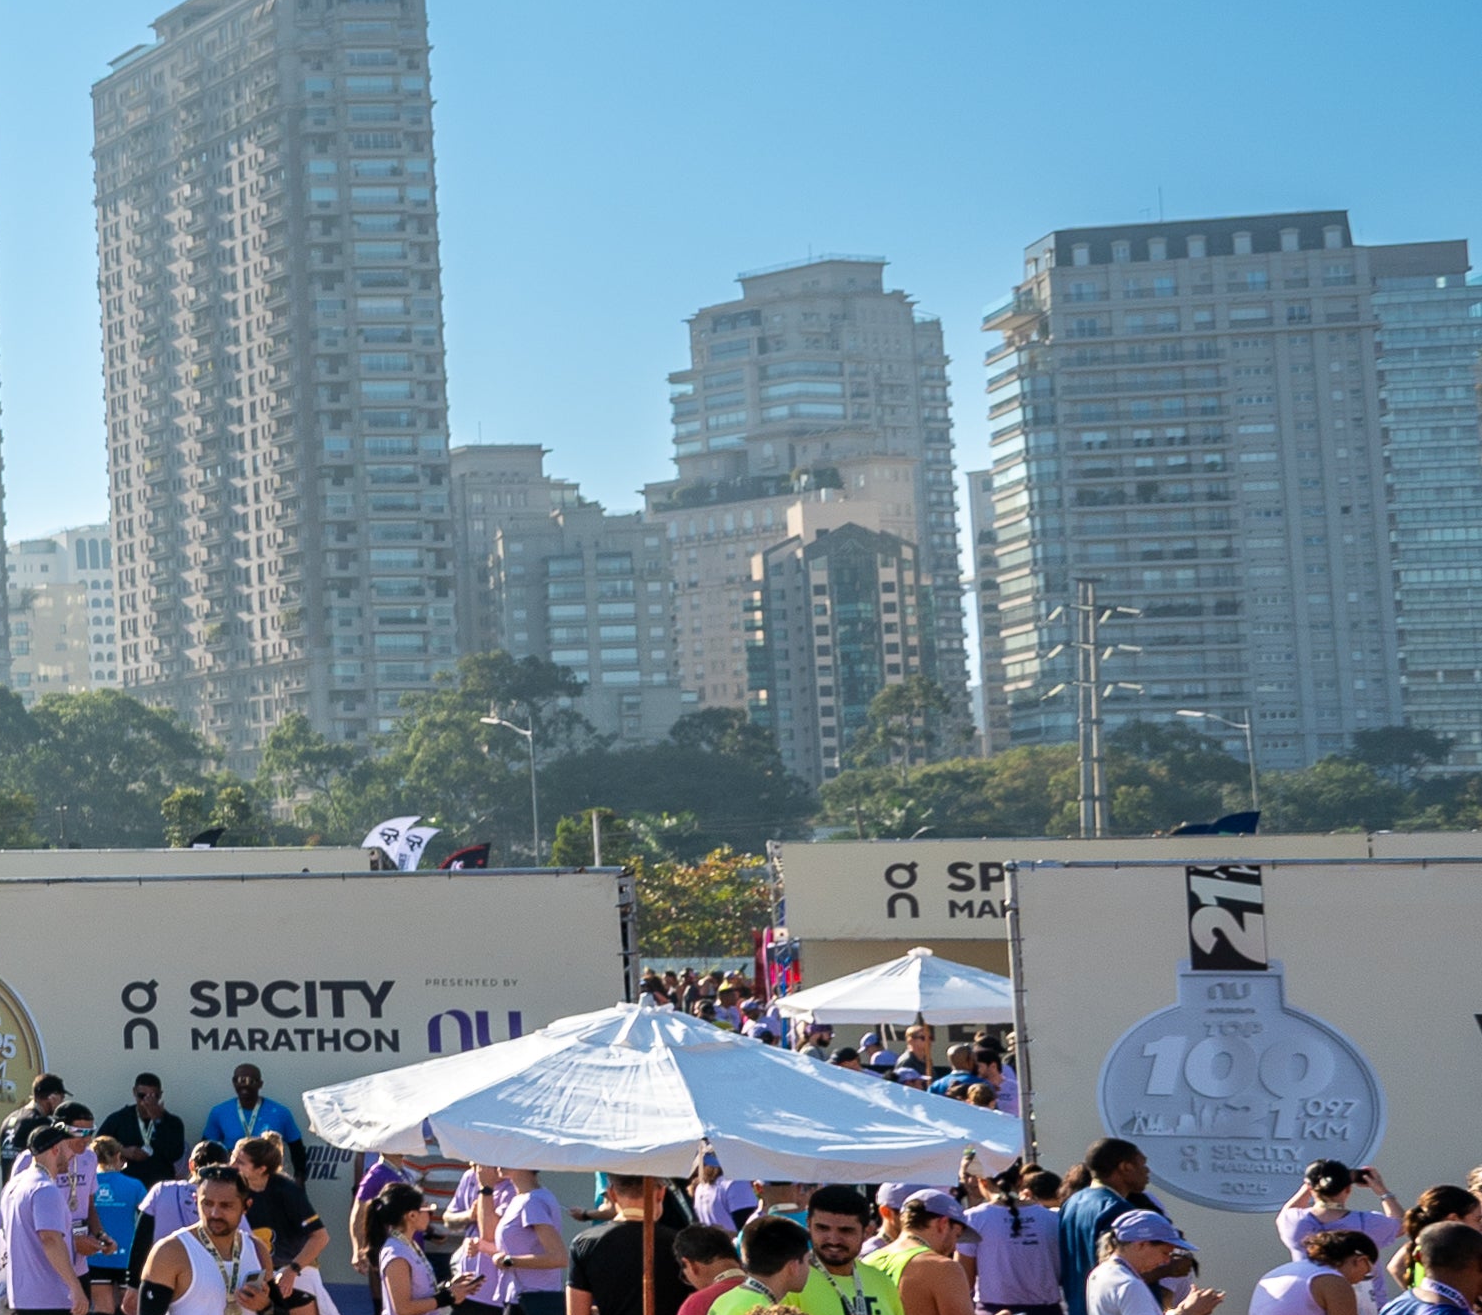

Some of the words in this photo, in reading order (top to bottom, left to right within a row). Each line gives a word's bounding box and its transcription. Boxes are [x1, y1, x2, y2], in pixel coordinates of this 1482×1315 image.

[425, 978, 498, 987] PRESENTED
[503, 978, 519, 987] BY
[190, 980, 396, 1019] SPCITY
[191, 1028, 401, 1054] MARATHON
[1299, 1122, 1353, 1140] KM
[1210, 1145, 1305, 1161] SPCITY
